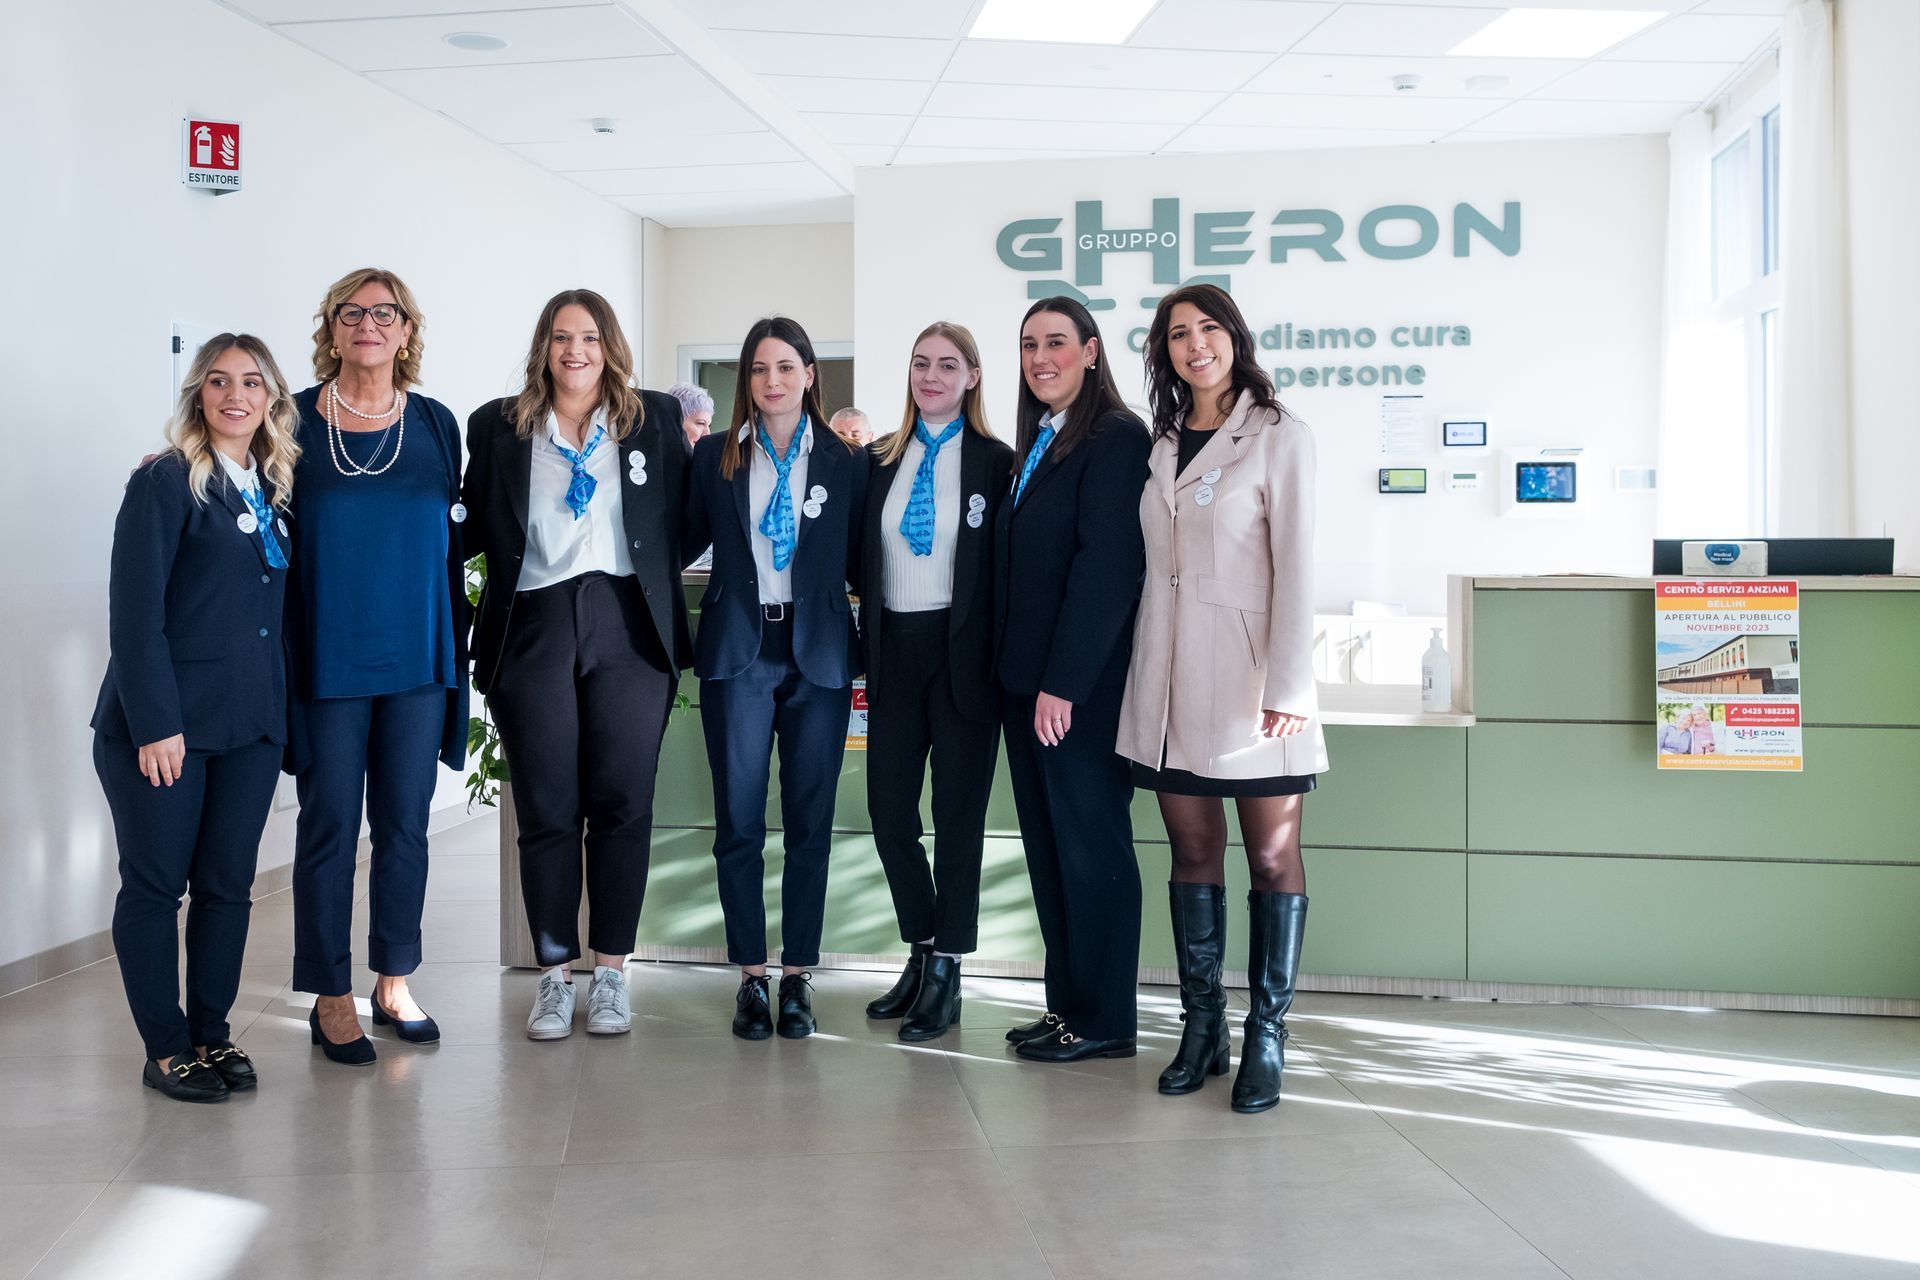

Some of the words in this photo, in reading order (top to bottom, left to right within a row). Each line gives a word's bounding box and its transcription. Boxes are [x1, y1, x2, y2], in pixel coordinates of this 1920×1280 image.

[188, 172, 239, 185] ESTINTORE
[996, 197, 1522, 286] GHERON
[1078, 231, 1177, 250] GRUPPO
[1390, 322, 1472, 348] cura
[1273, 363, 1427, 394] persone
[1664, 585, 1704, 594] CENTRO
[1707, 585, 1745, 594] SERVIZI
[1747, 585, 1789, 594] ANZIANI
[1707, 599, 1746, 608] BELLINI
[1664, 613, 1720, 621] APERTURA
[1723, 613, 1736, 621] AL
[1740, 613, 1792, 621] PUBBLICO
[1686, 624, 1743, 632] NOVEMBRE
[1746, 624, 1770, 632] 2023
[1742, 707, 1762, 715] 0425
[1734, 729, 1785, 737] GHERON
